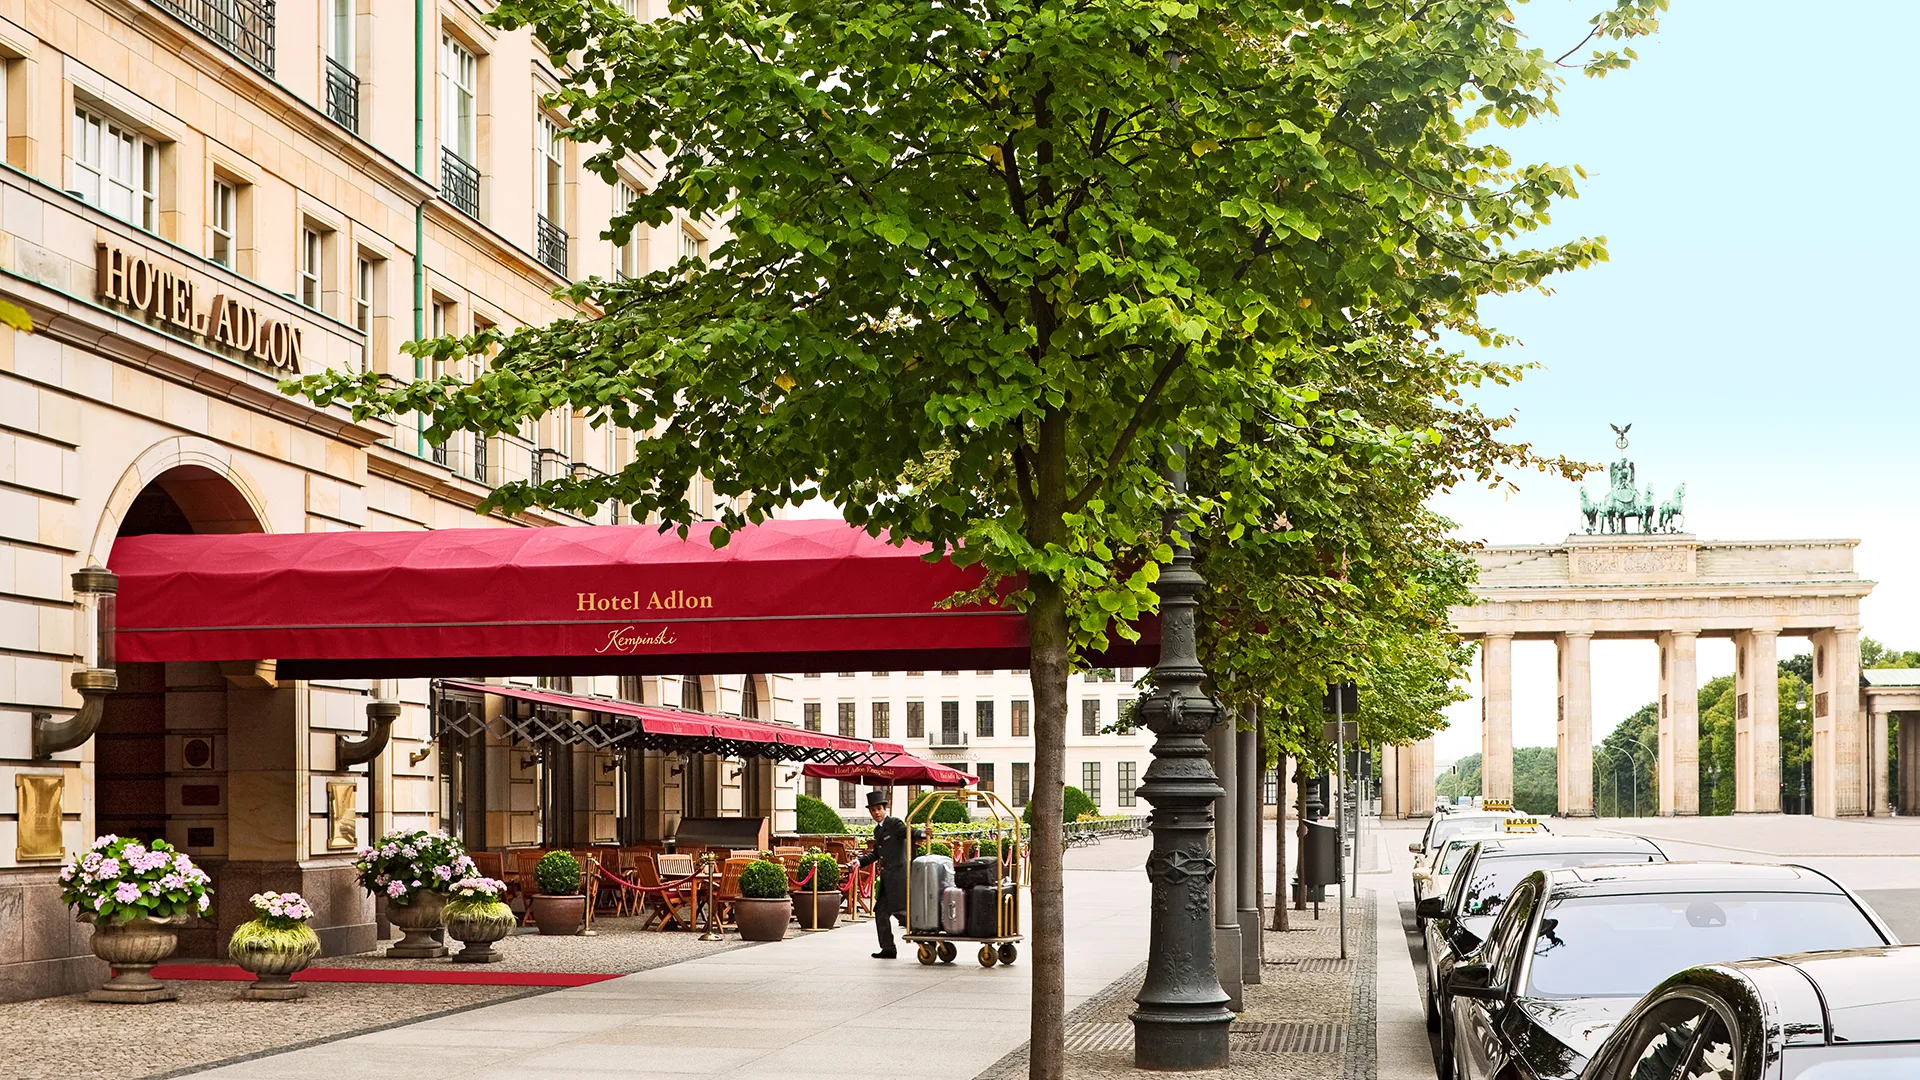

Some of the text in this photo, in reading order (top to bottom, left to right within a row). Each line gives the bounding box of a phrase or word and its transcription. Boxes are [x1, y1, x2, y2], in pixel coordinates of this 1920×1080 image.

[101, 244, 304, 374] HOTEL ADLON
[576, 589, 714, 611] Hotel Adlon
[595, 625, 677, 654] Kempinski
